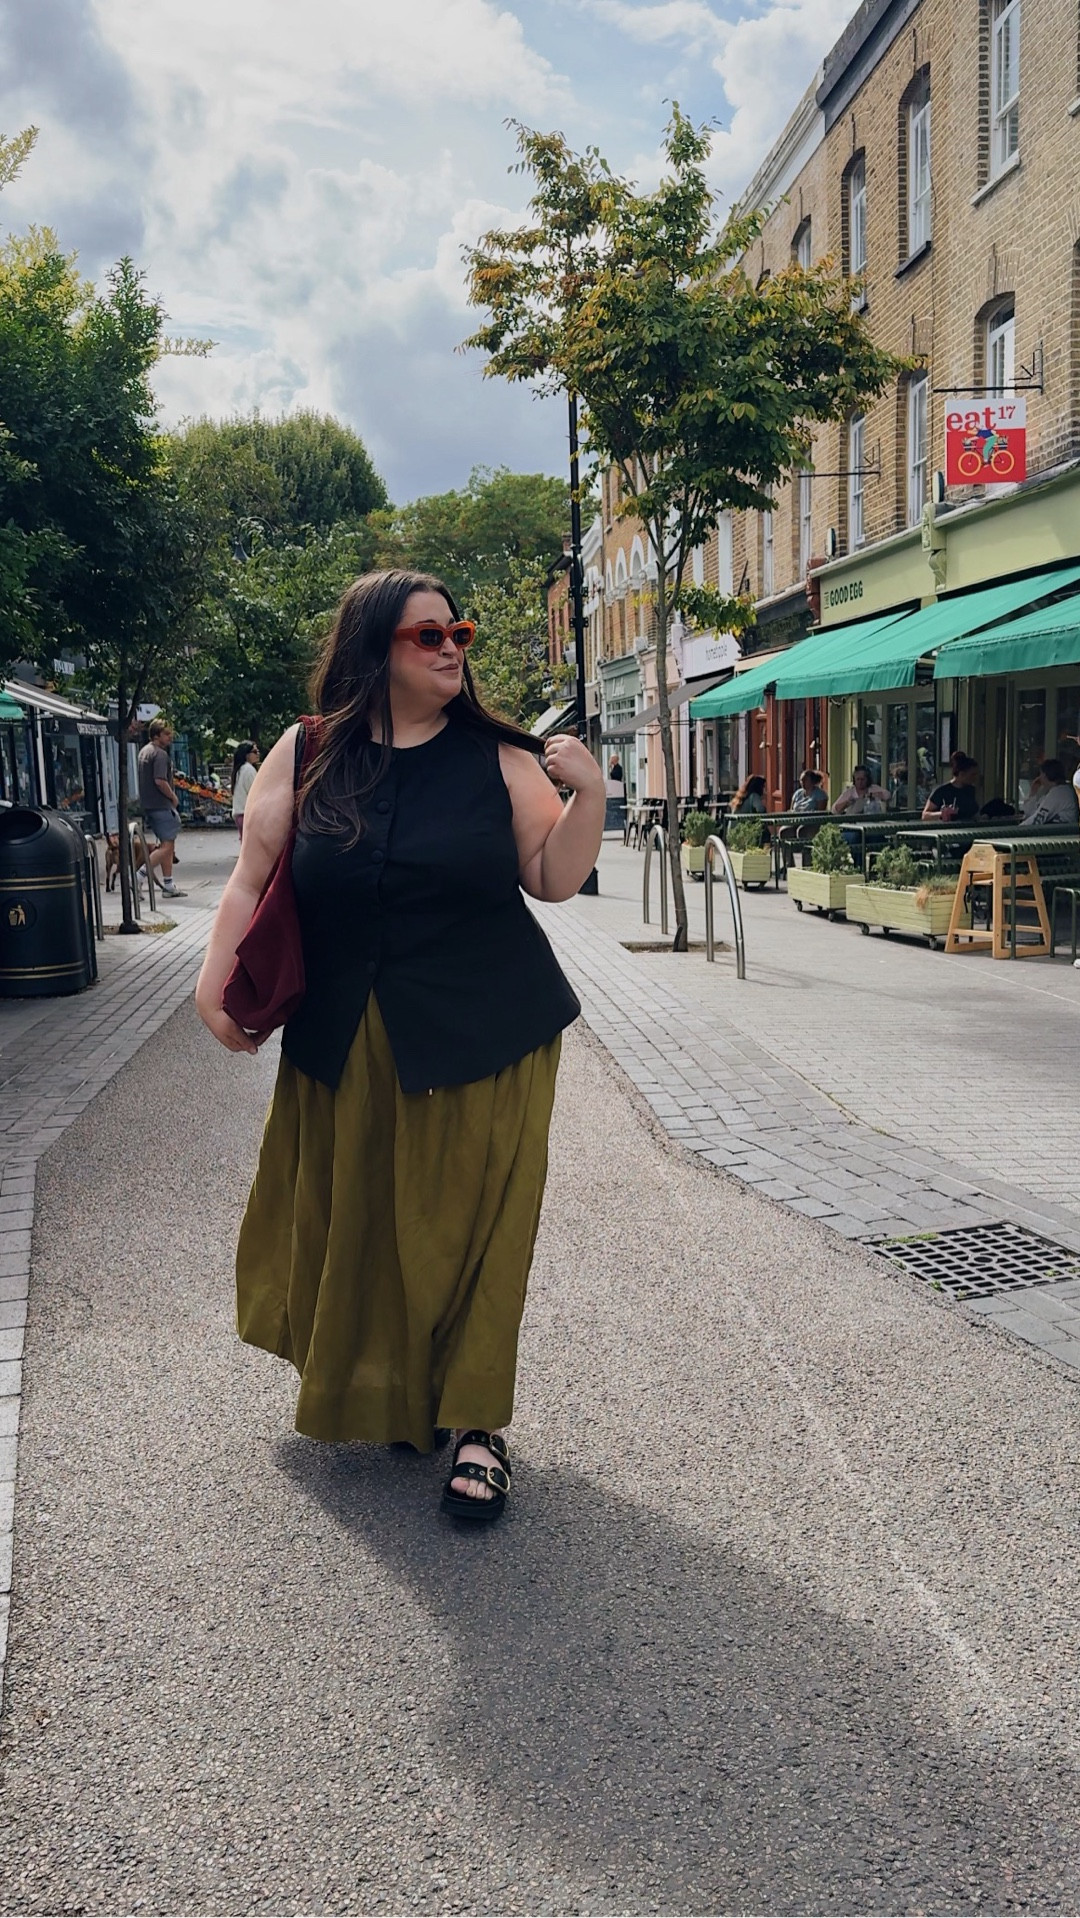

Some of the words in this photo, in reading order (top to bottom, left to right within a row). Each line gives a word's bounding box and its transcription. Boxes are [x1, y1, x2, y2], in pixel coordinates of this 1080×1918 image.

[946, 406, 996, 432] eat
[998, 406, 1016, 419] 17
[830, 585, 849, 606] GOOD
[850, 580, 863, 600] EGG
